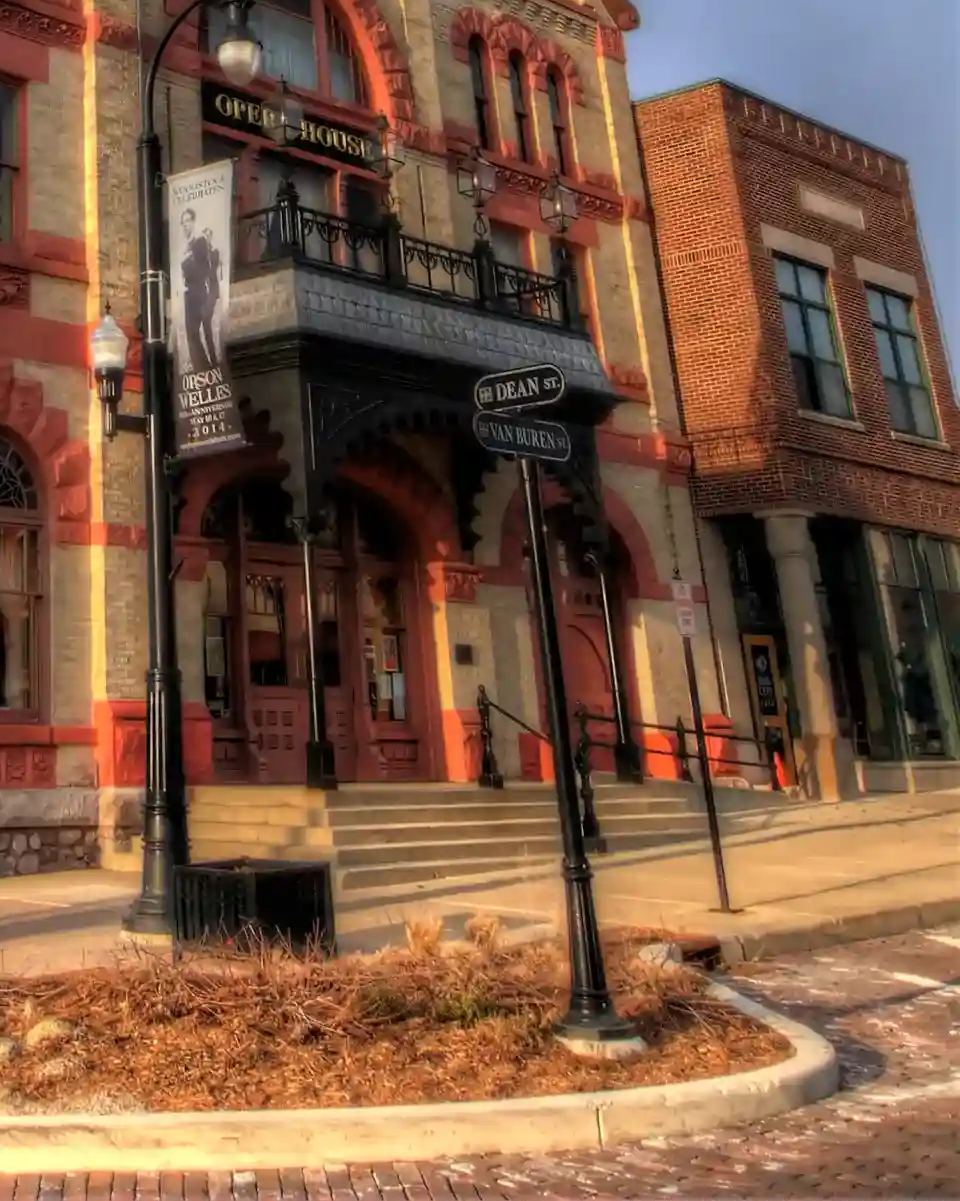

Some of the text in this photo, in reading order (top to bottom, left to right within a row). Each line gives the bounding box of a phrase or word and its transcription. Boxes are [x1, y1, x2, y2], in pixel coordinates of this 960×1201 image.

[215, 93, 374, 160] OPER HOUSE
[182, 367, 223, 391] ORSON
[496, 377, 560, 401] DEAN ST.
[178, 383, 232, 410] WELLES
[489, 421, 514, 443] VAN
[515, 426, 557, 450] BUREN
